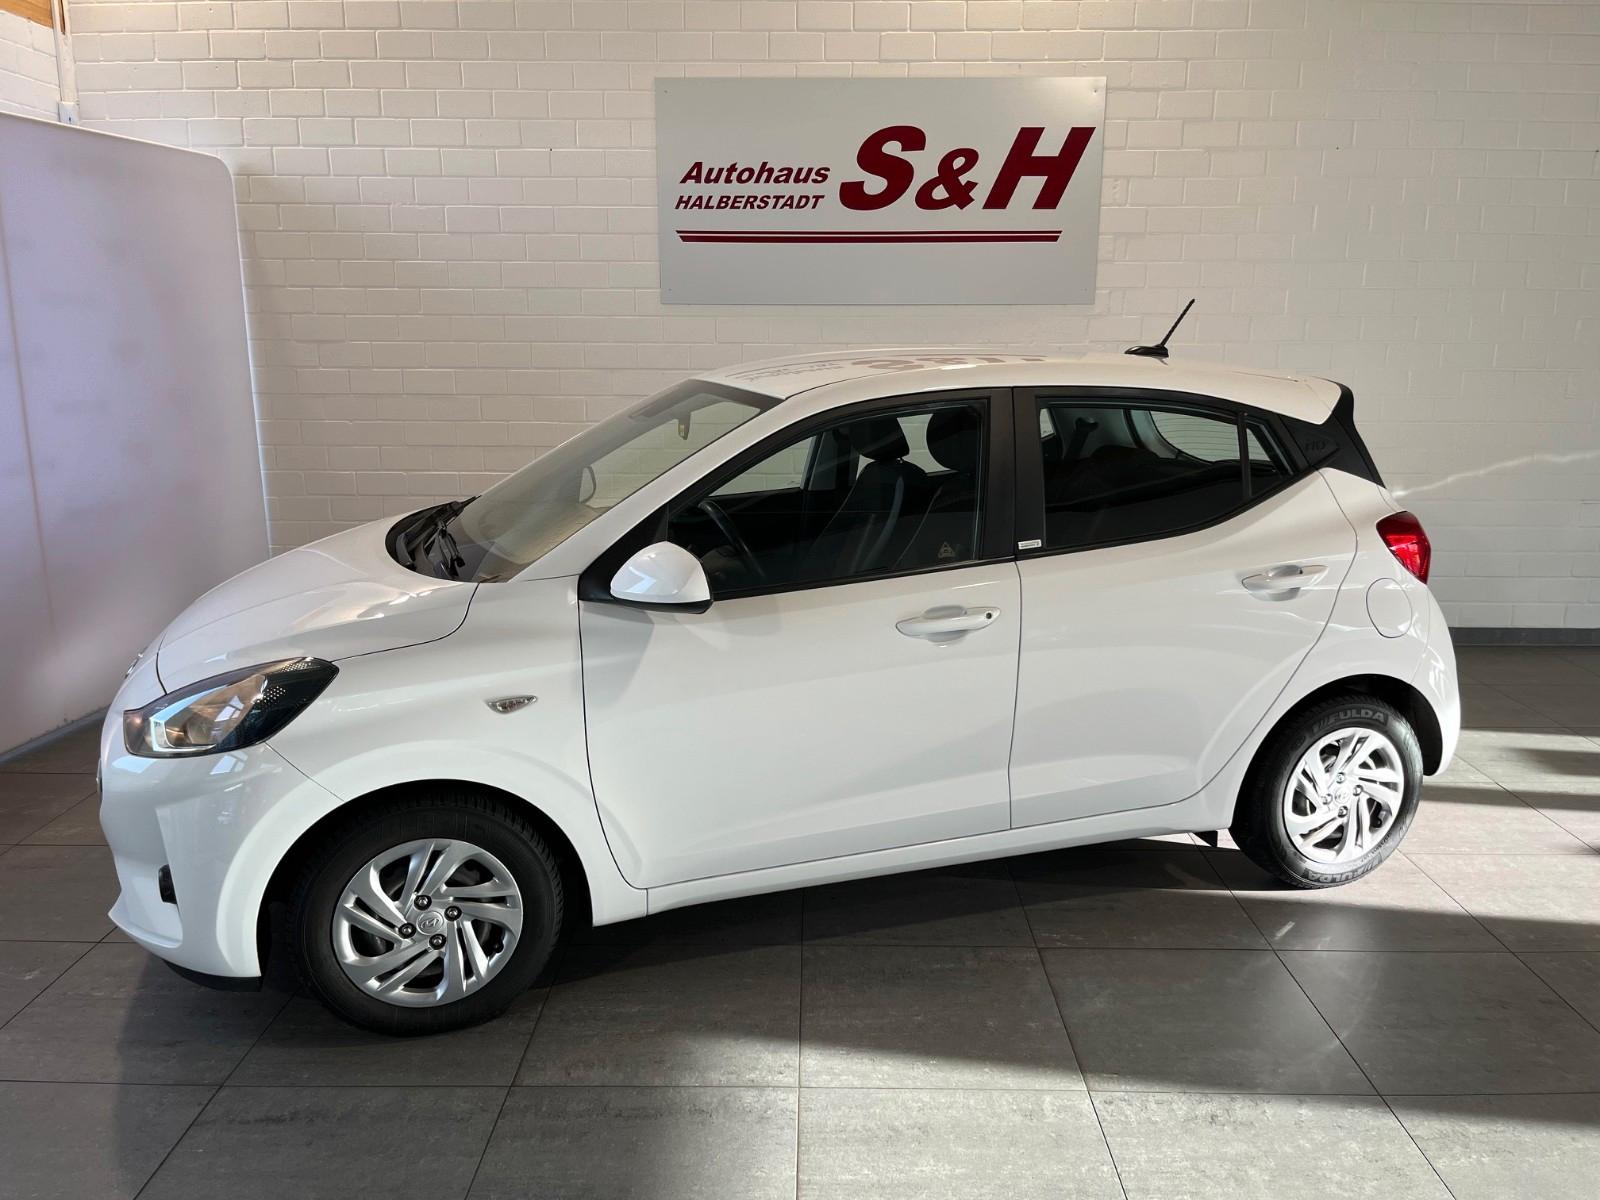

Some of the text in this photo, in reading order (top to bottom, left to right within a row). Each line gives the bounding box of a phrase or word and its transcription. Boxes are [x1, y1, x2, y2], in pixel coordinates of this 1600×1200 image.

[679, 161, 830, 185] Autohaus
[675, 194, 826, 210] HALBERSTADT
[1327, 708, 1385, 724] FULDA
